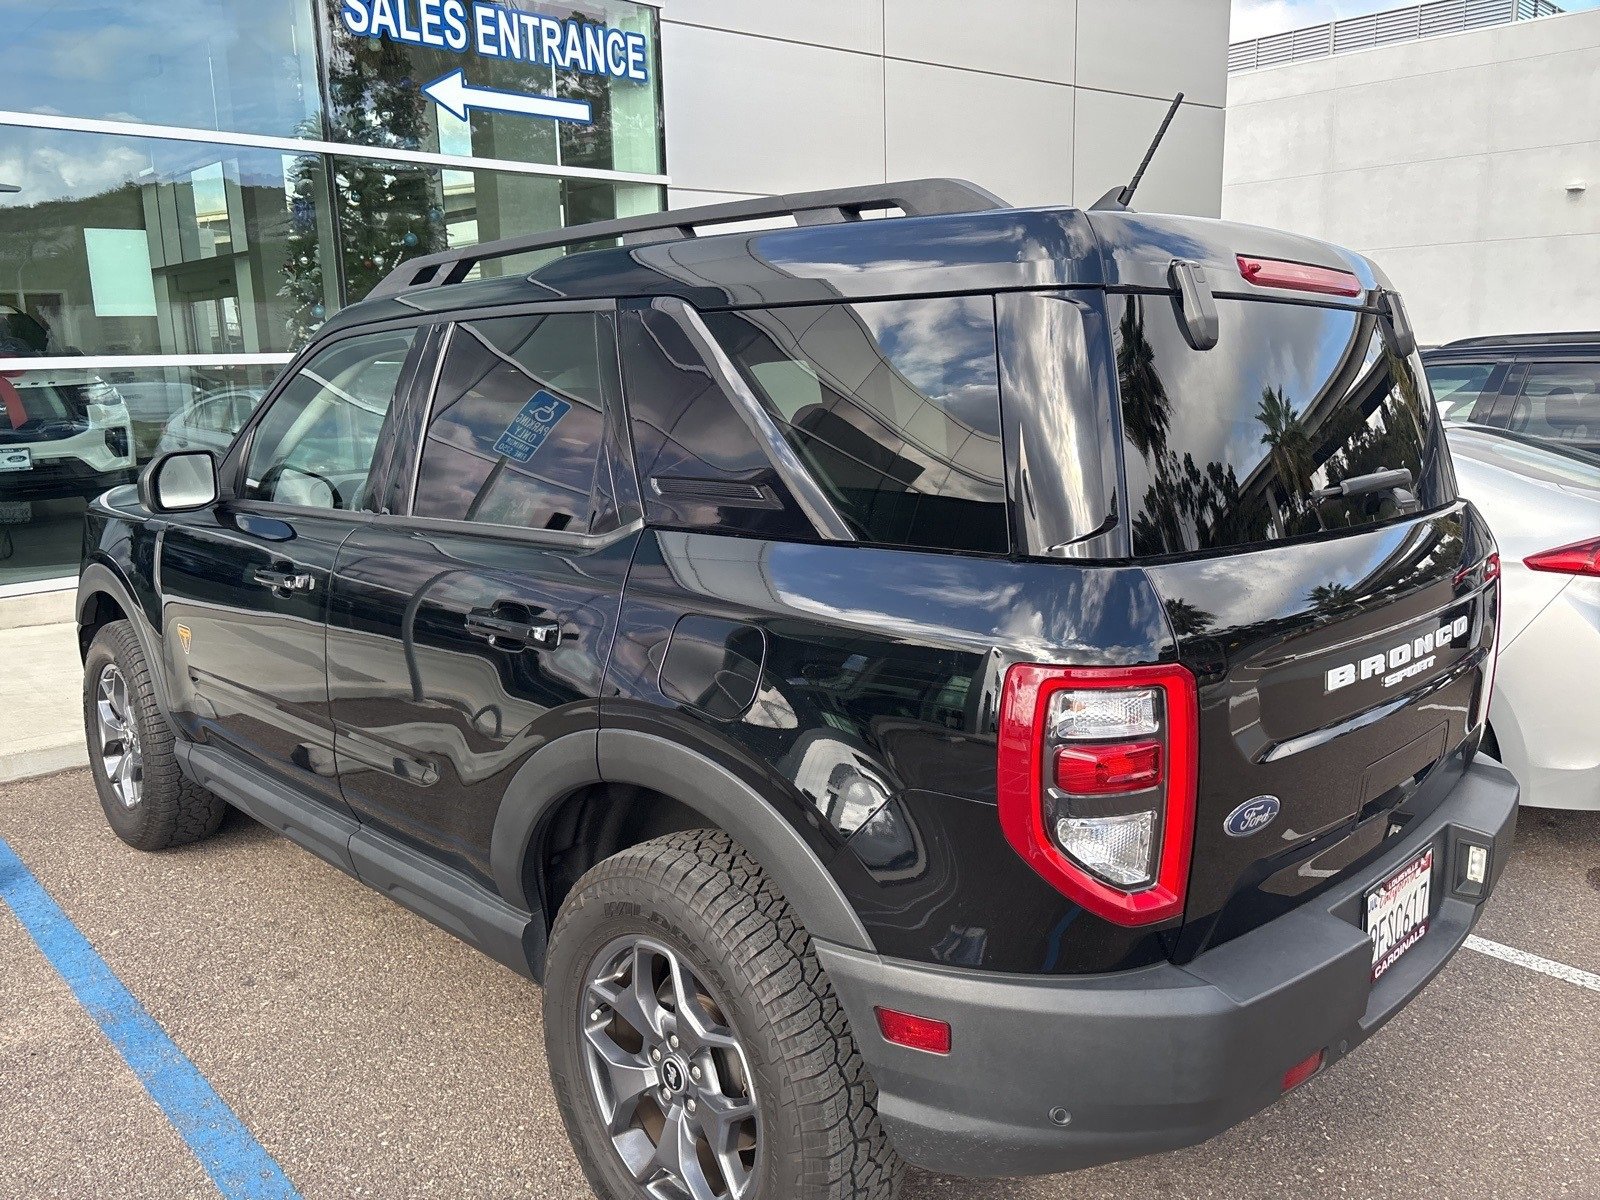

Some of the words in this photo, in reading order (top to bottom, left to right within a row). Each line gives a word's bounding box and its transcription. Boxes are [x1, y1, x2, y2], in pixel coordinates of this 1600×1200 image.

[343, 0, 467, 50] SALES
[474, 8, 648, 81] ENTRANCE
[1327, 615, 1468, 691] BRONCO
[1382, 655, 1437, 688] SPORT
[1239, 804, 1277, 831] Ford
[1387, 861, 1419, 890] LOUISVILLE
[1374, 925, 1426, 979] CARDINALS
